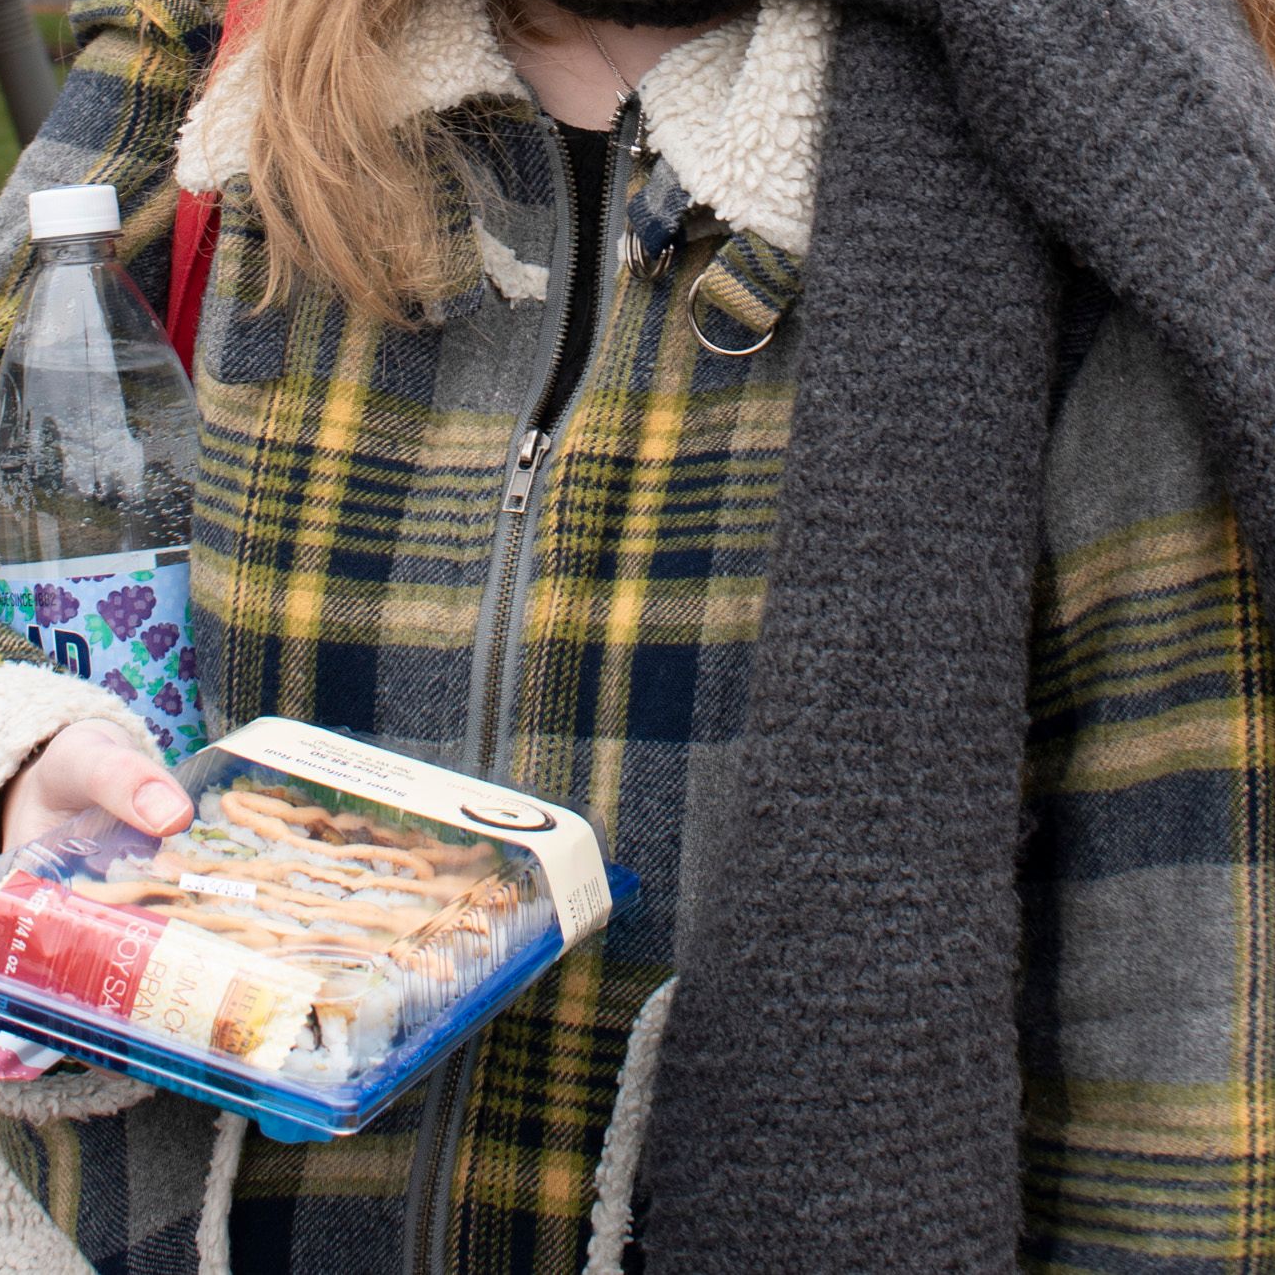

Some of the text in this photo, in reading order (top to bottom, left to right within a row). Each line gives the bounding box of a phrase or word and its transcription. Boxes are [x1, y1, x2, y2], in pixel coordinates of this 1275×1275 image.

[263, 748, 408, 798] Super California Roll
[353, 765, 389, 780] Price
[15, 915, 35, 939] 1/4
[10, 938, 27, 952] fl.
[112, 920, 149, 979] SOY
[4, 954, 19, 975] oz.
